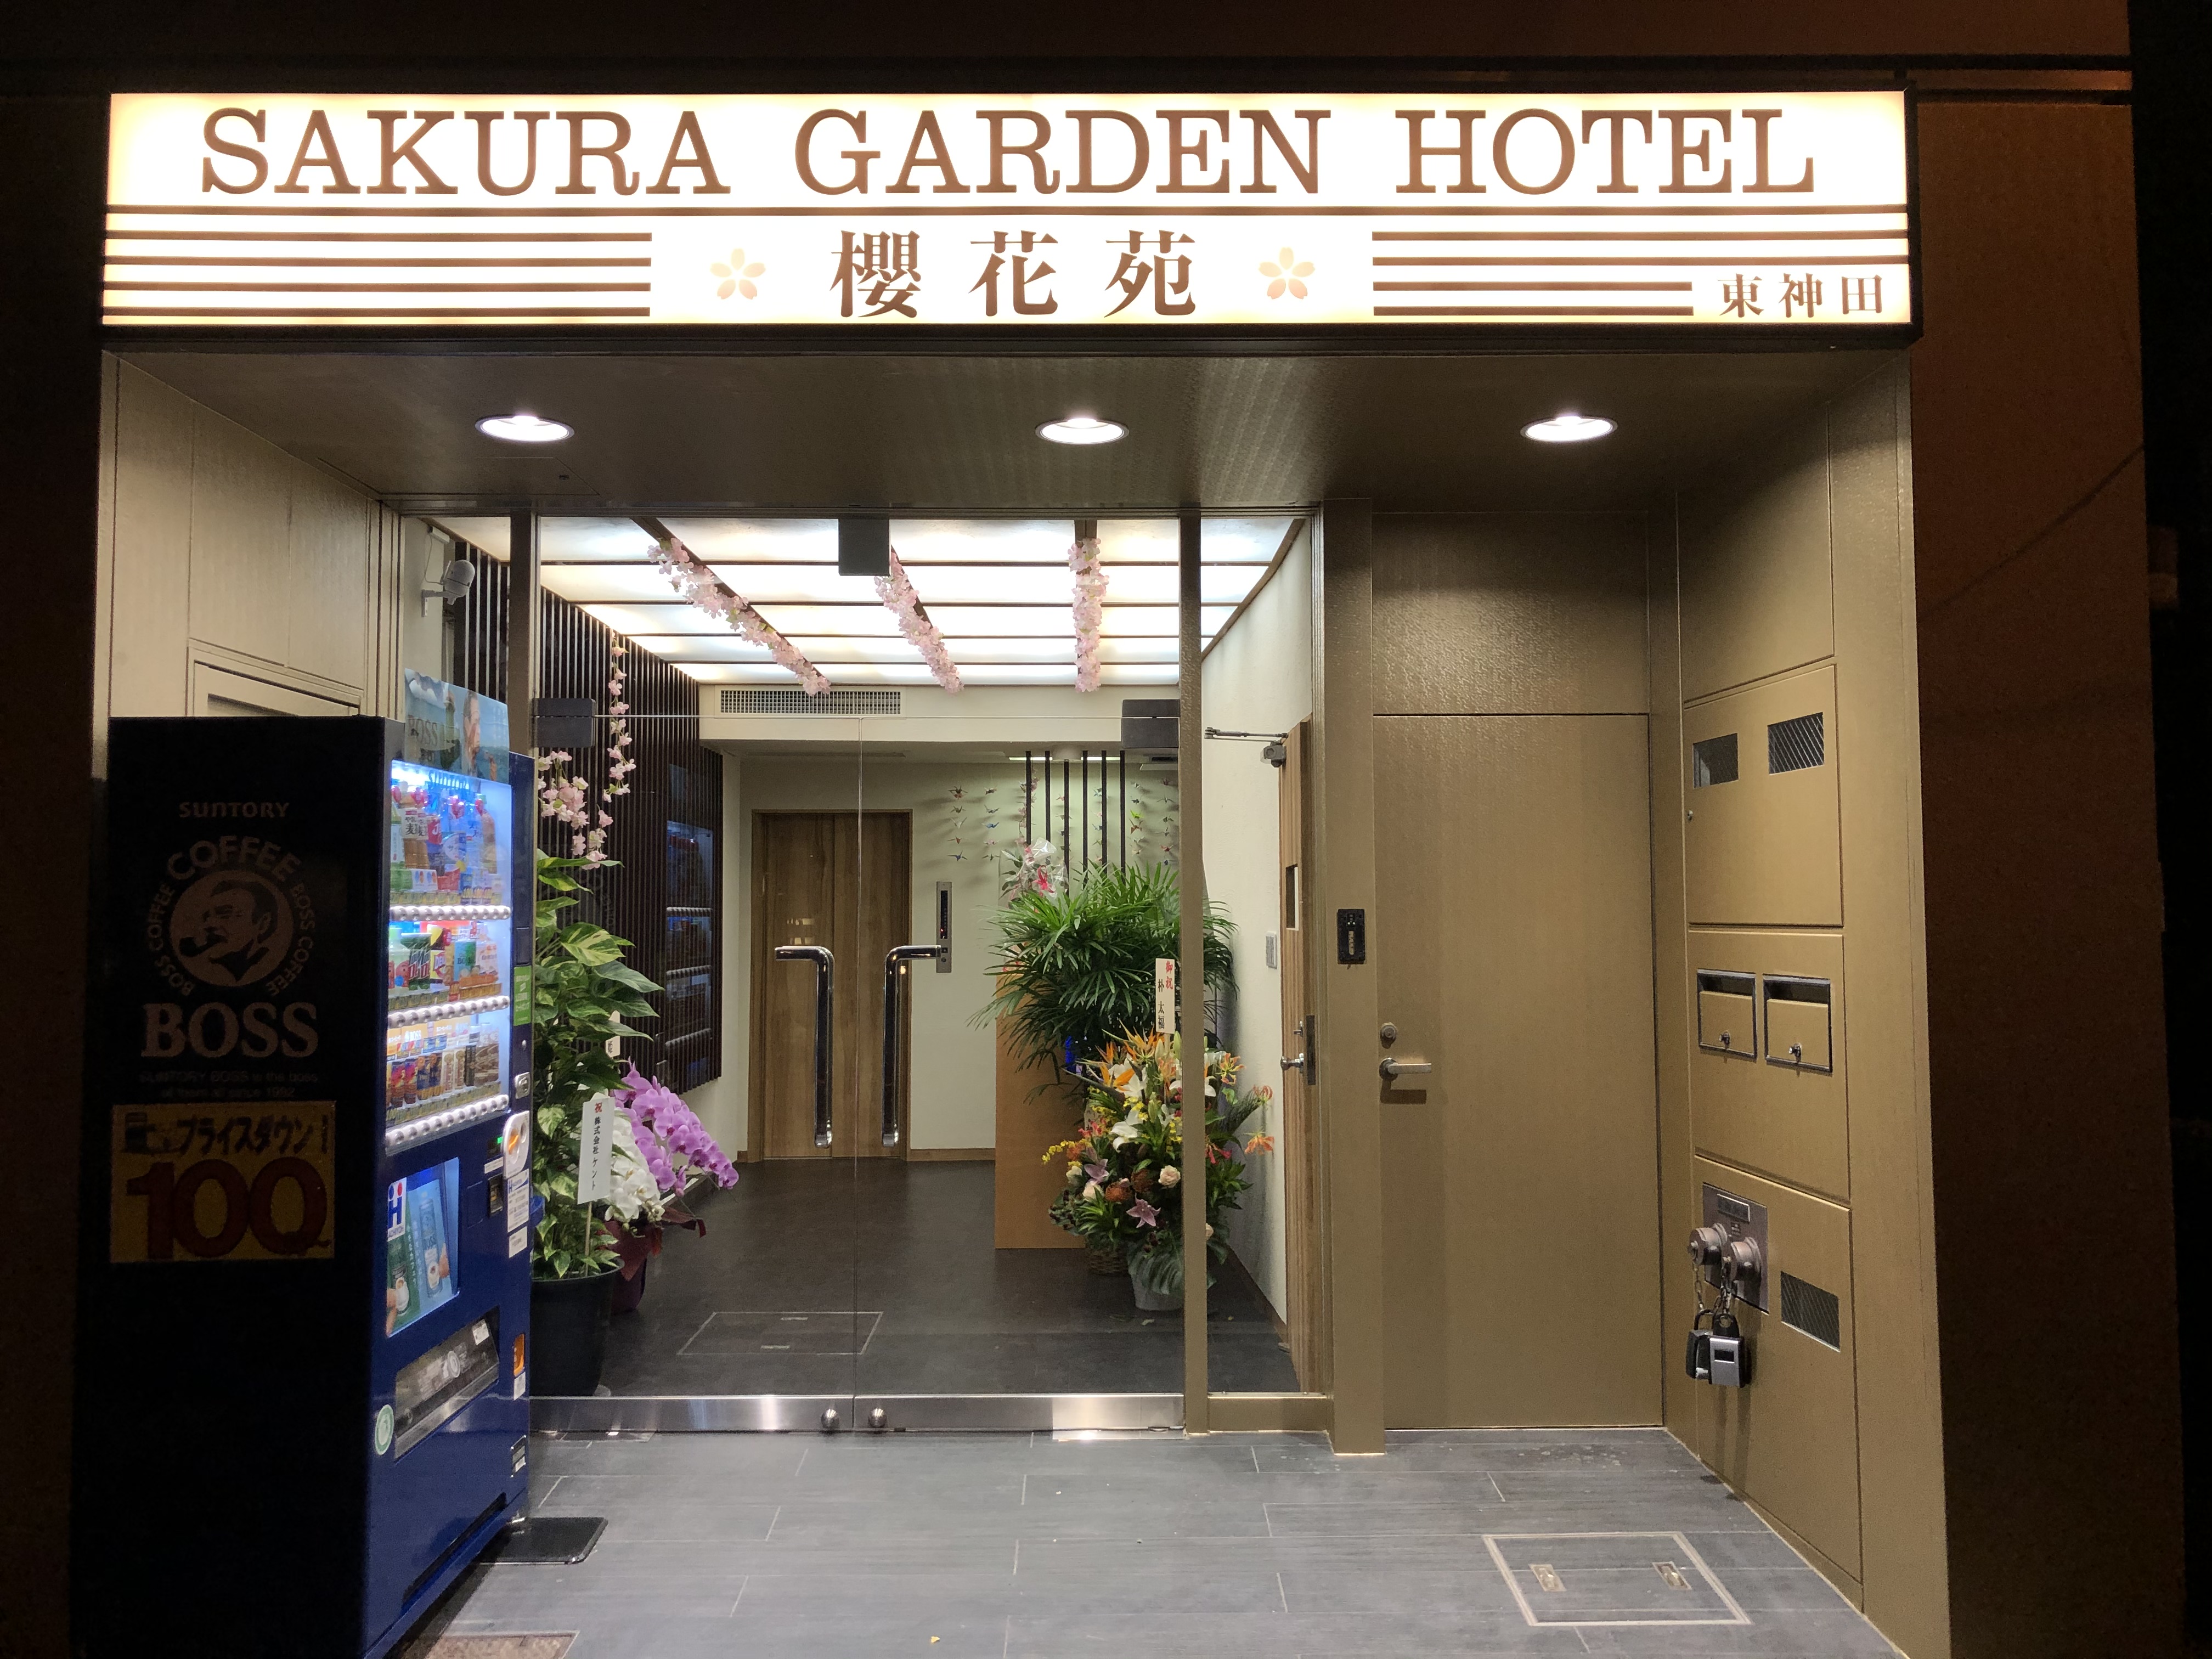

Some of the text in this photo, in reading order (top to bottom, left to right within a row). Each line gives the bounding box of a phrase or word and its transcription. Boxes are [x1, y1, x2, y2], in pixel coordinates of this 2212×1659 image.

[202, 108, 1814, 197] SAKURA GARDEN HOTEL
[831, 230, 1197, 318] 櫻花苑
[1717, 273, 1884, 318] 東神田
[179, 801, 290, 818] SUNTORY
[167, 836, 302, 879] COFFEE
[140, 1001, 319, 1058] BOSS
[595, 1102, 602, 1113] 祝
[592, 1116, 601, 1190] 株式会社ケント
